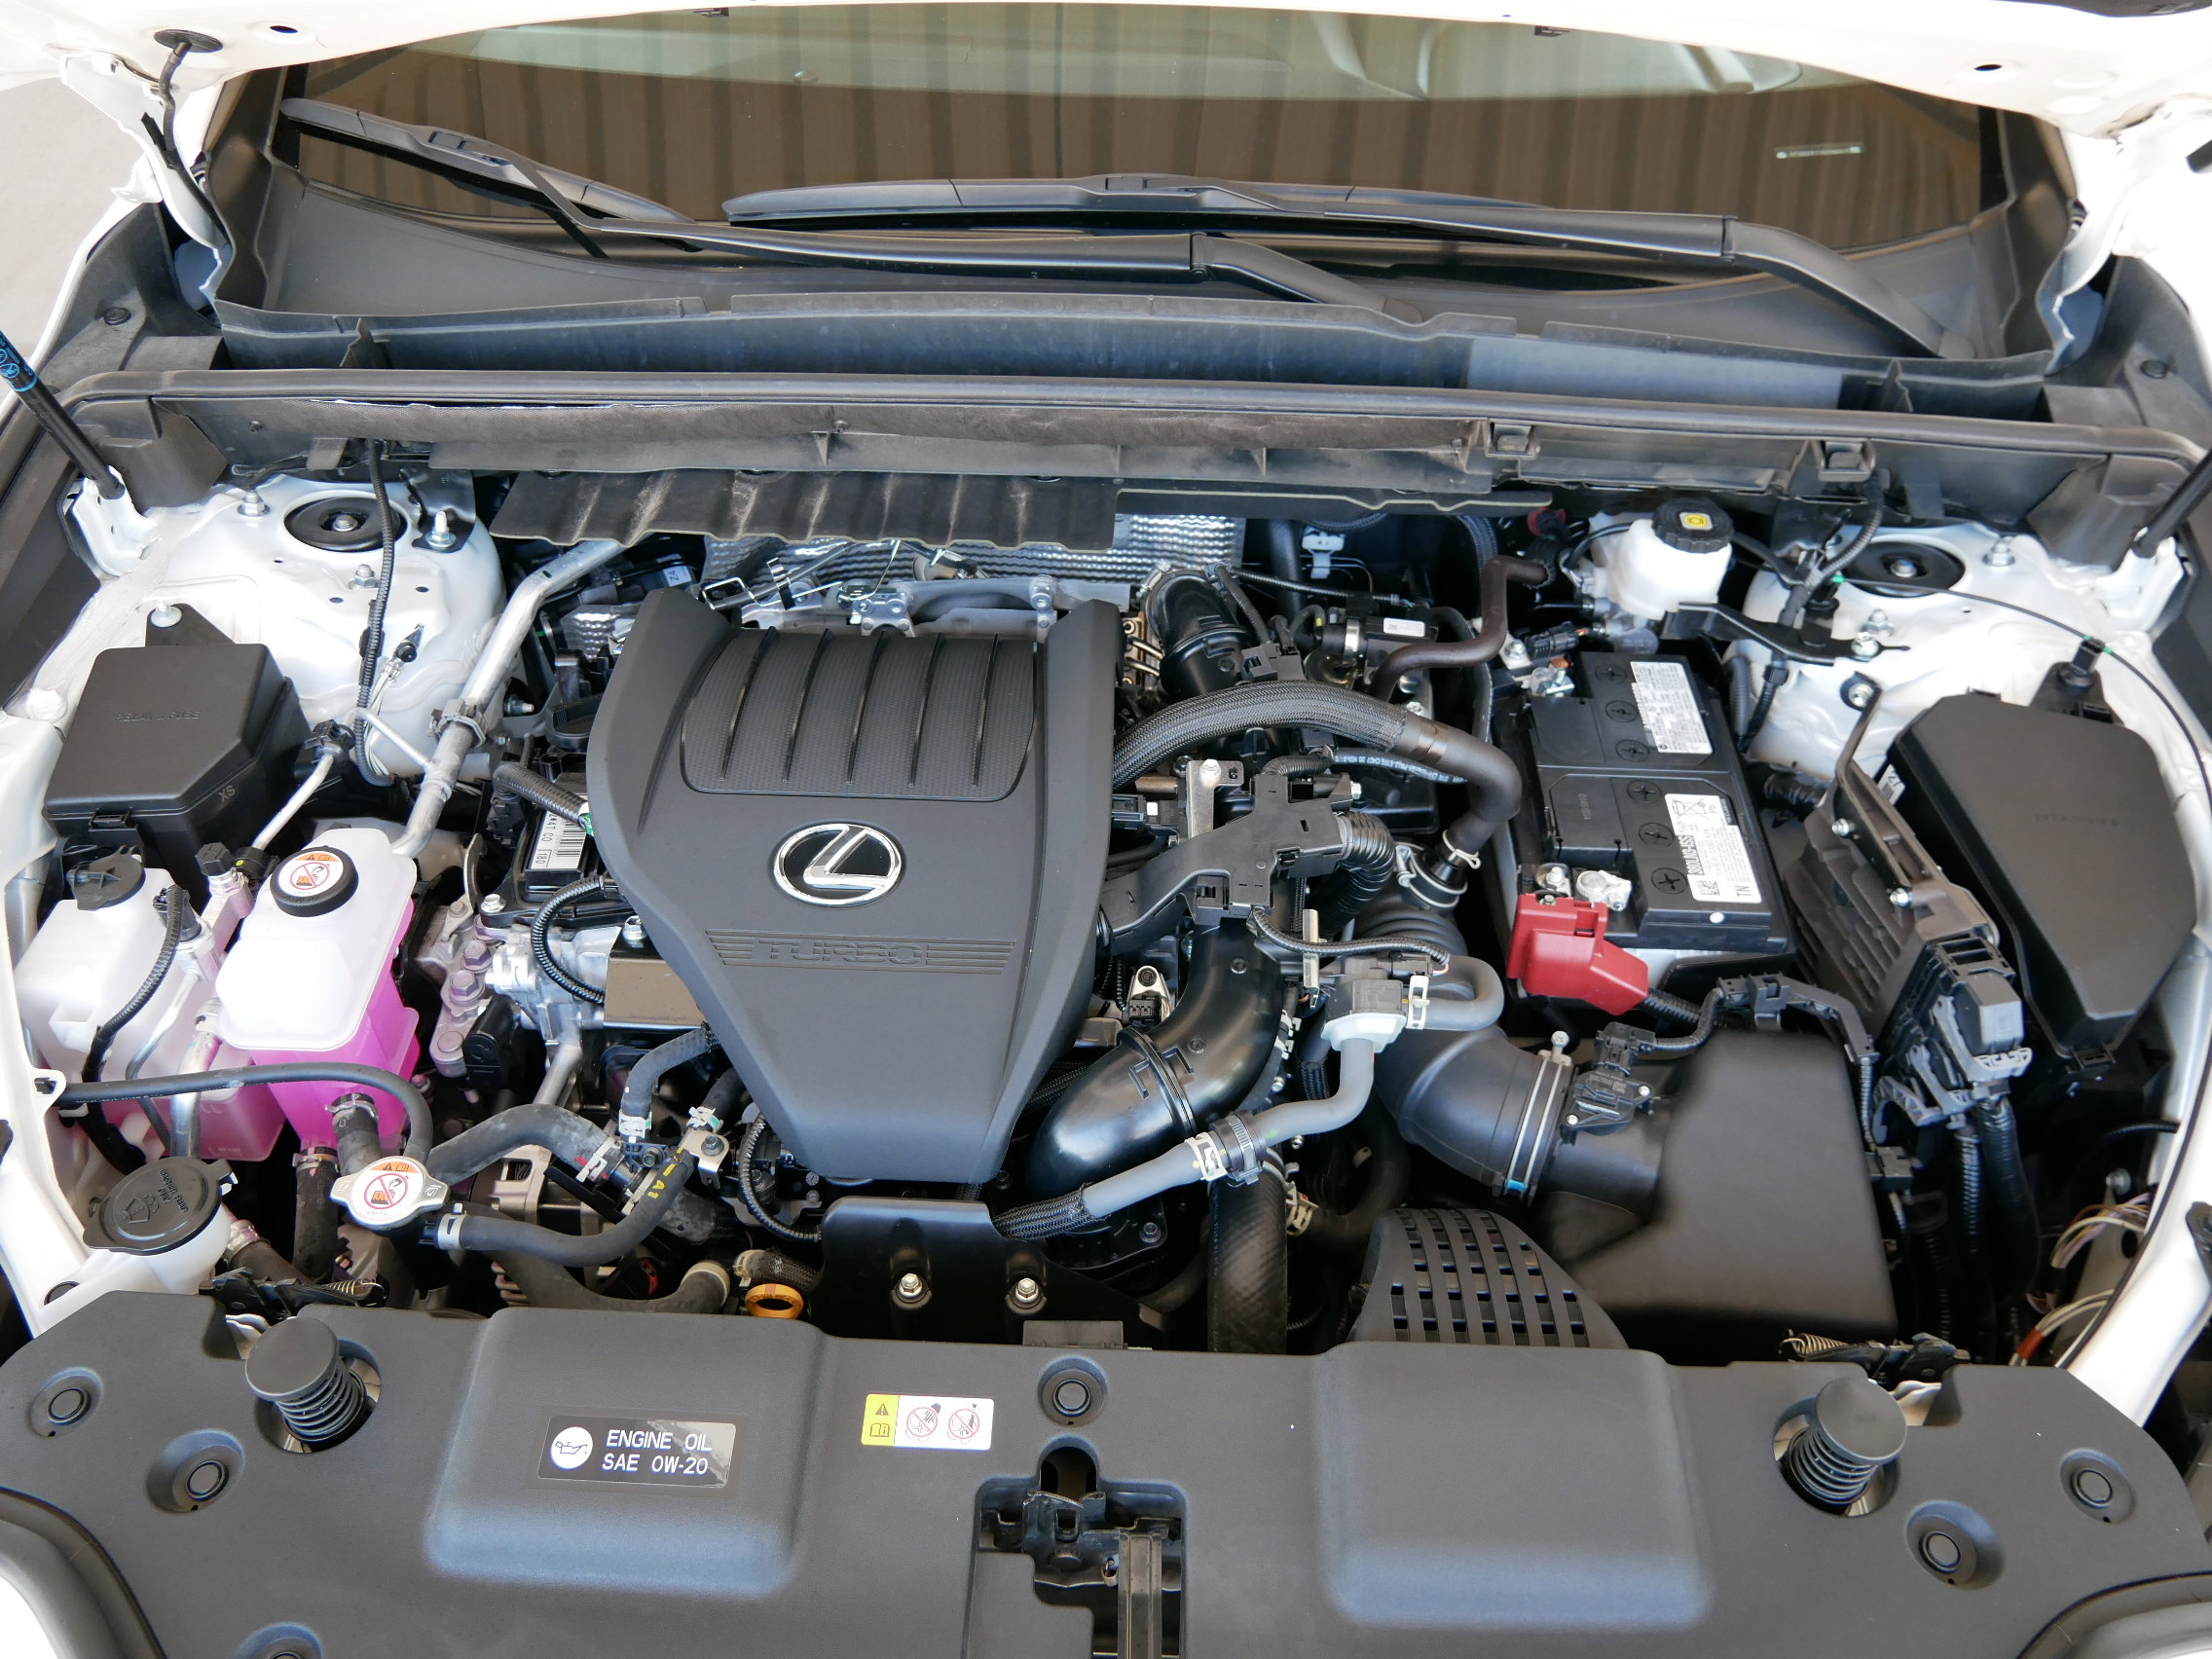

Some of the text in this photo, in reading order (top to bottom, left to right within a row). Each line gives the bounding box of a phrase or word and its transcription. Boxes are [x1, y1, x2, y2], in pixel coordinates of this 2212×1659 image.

[758, 936, 923, 965] TURBO
[606, 1429, 713, 1453] ENGINE OIL
[602, 1453, 709, 1475] SAE 0W-20
